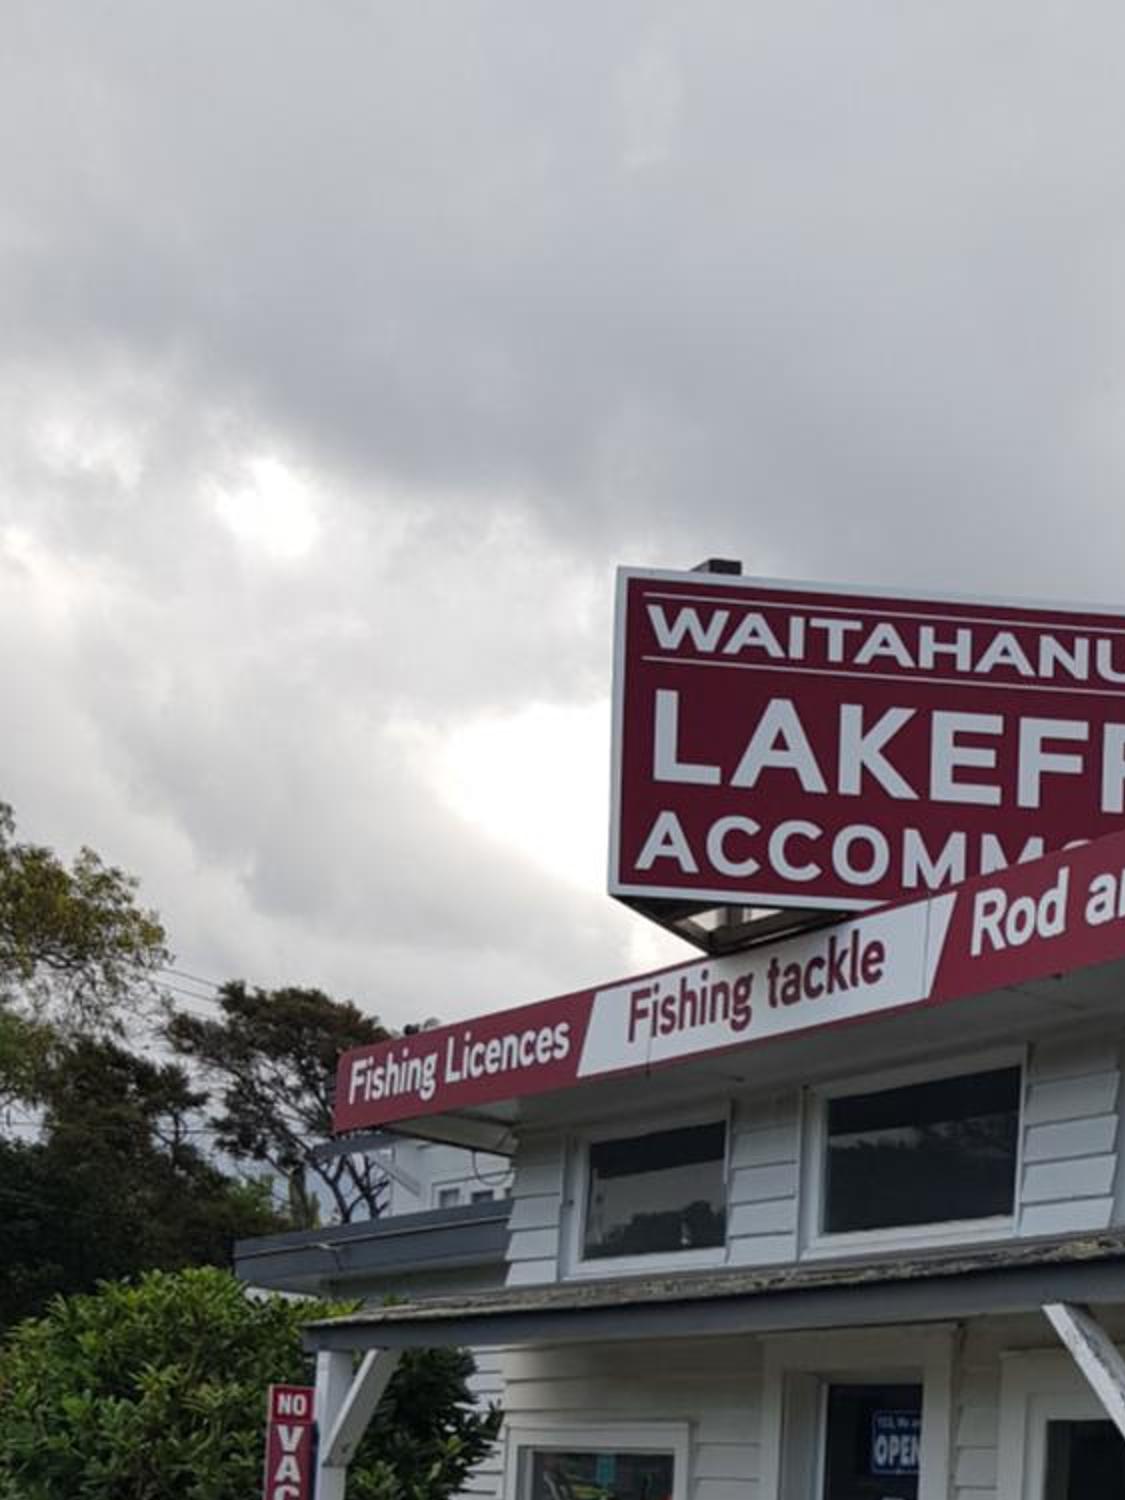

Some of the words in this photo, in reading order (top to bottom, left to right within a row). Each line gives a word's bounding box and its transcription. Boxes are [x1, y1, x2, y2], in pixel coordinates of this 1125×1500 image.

[635, 811, 1090, 889] ACCOM
[970, 867, 1070, 956] Rod
[627, 968, 754, 1042] Fishing
[767, 928, 886, 1009] tackle
[348, 1043, 437, 1105] Fishing
[444, 1021, 570, 1084] Licences
[277, 1393, 307, 1416] NO
